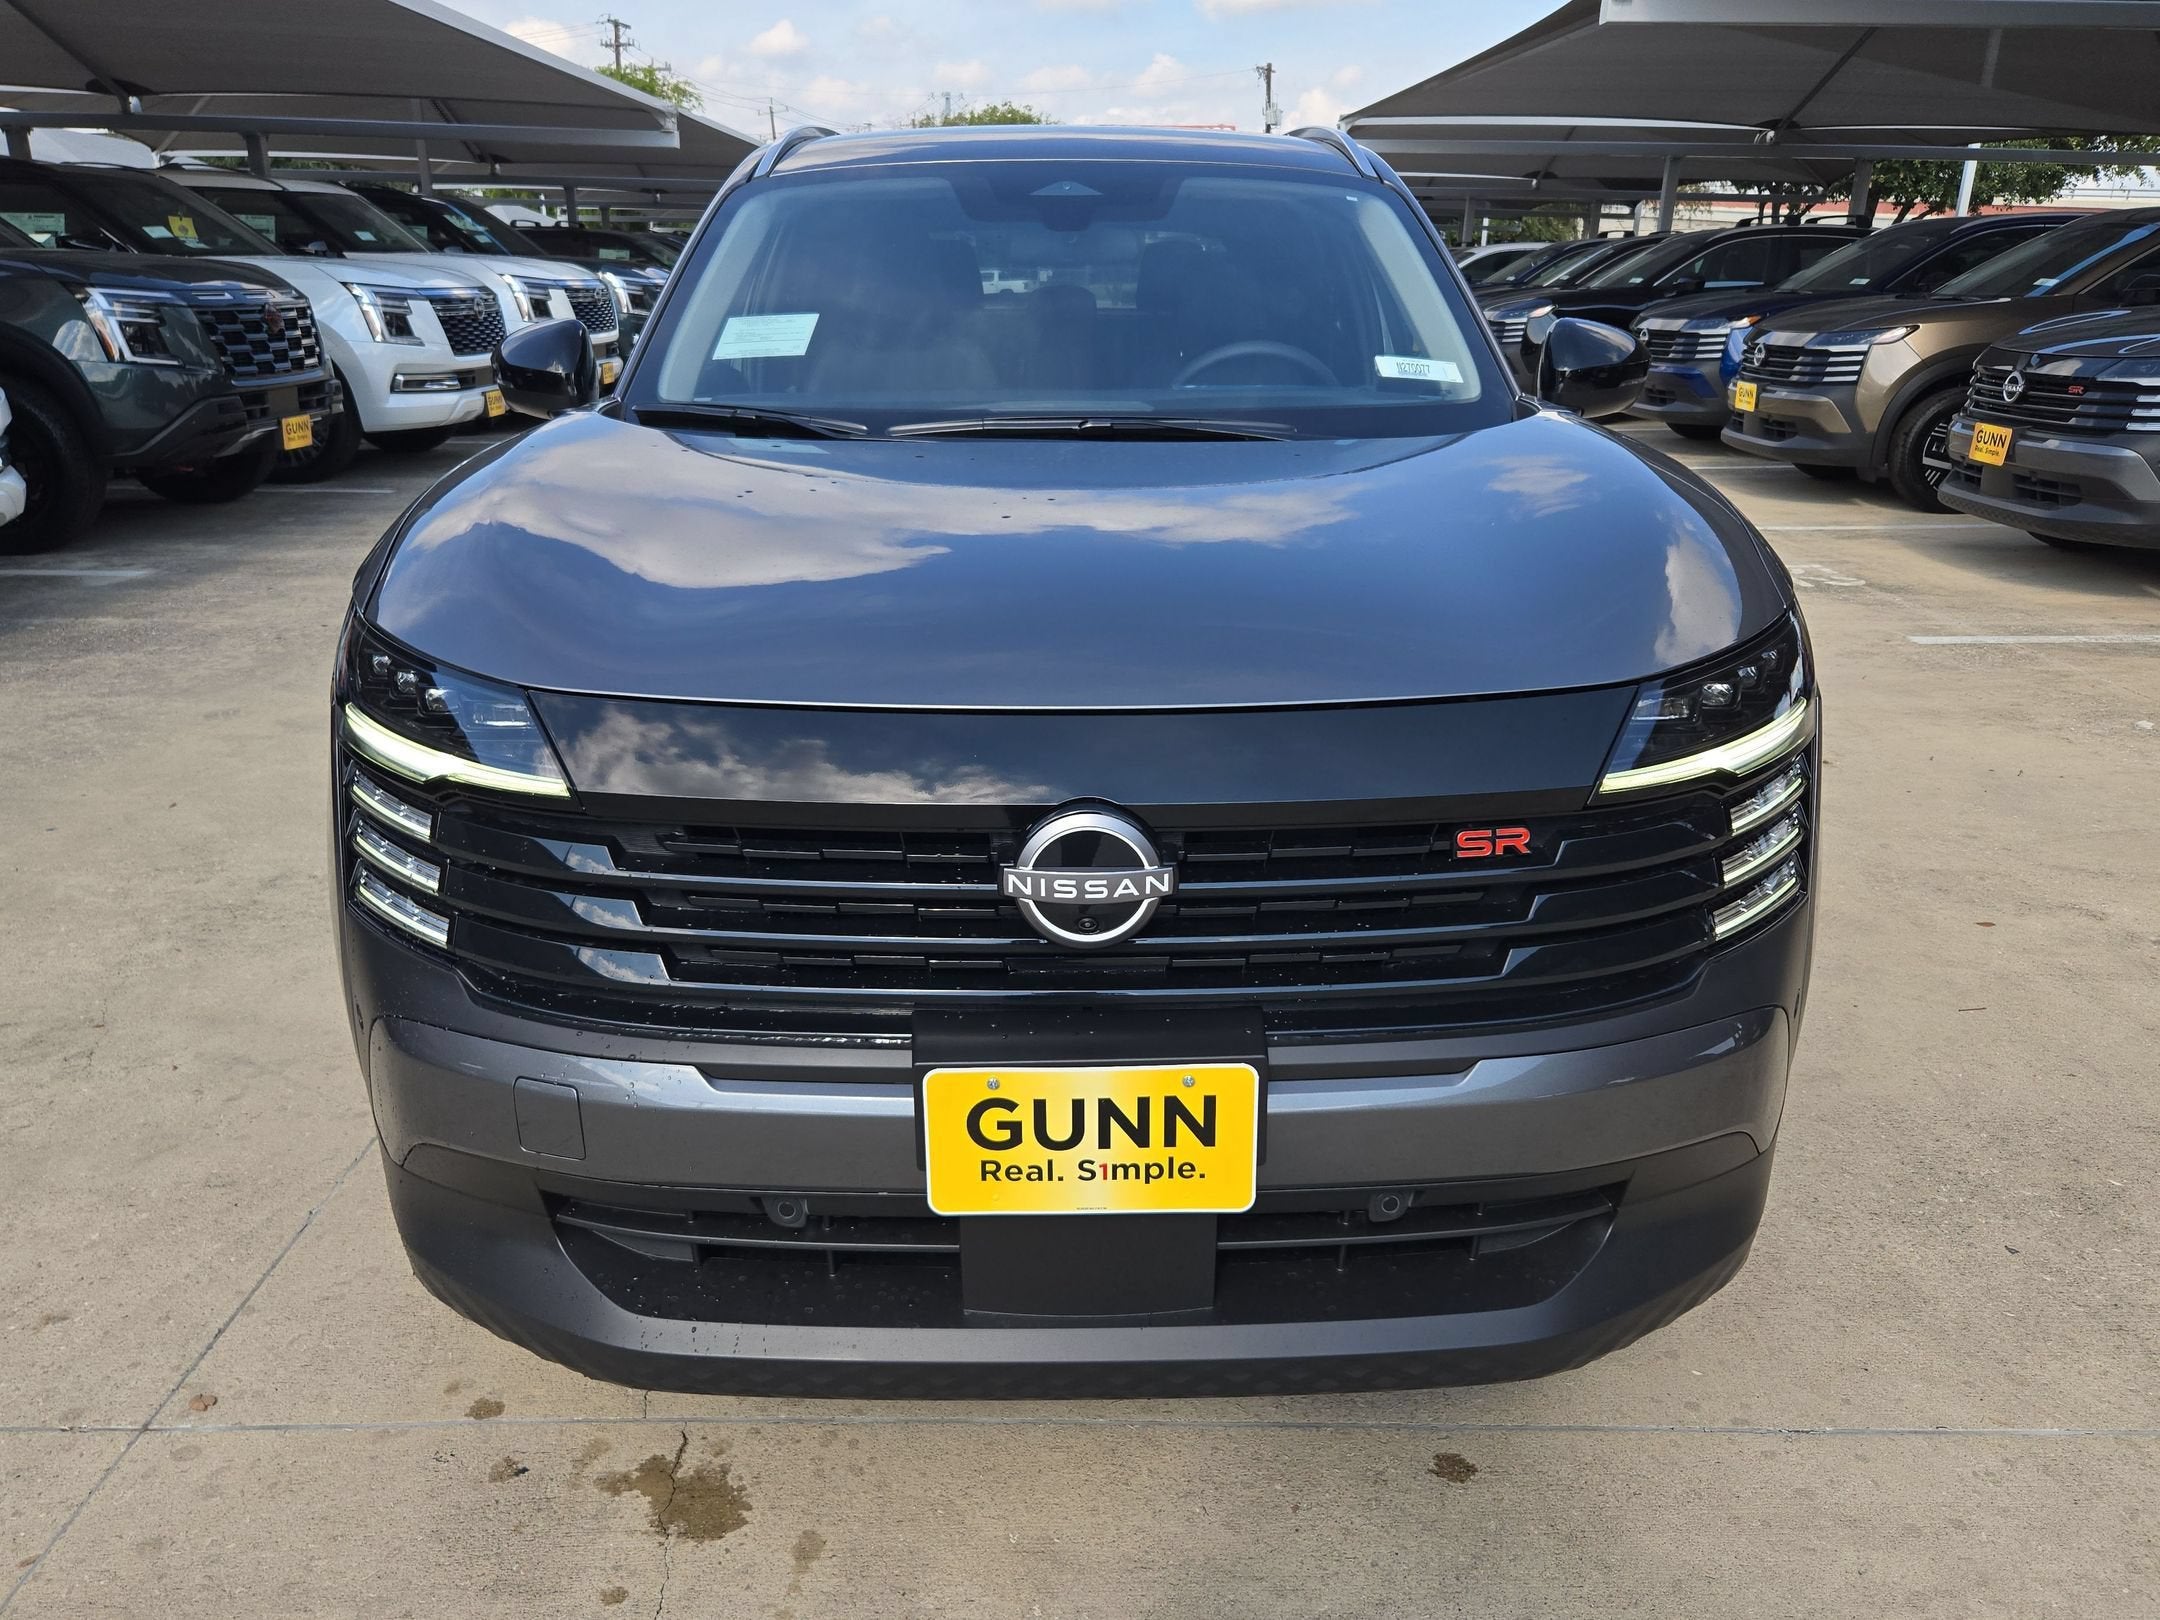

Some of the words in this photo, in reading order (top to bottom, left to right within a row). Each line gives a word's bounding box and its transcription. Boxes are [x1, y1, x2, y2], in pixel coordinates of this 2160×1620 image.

[2068, 385, 2085, 394] SR
[286, 420, 309, 435] GUNN
[1976, 430, 2007, 449] GUNN
[1457, 827, 1532, 858] SR
[1008, 873, 1169, 899] NISSAN
[966, 1094, 1217, 1151] GUNN
[980, 1158, 1064, 1182] Real.
